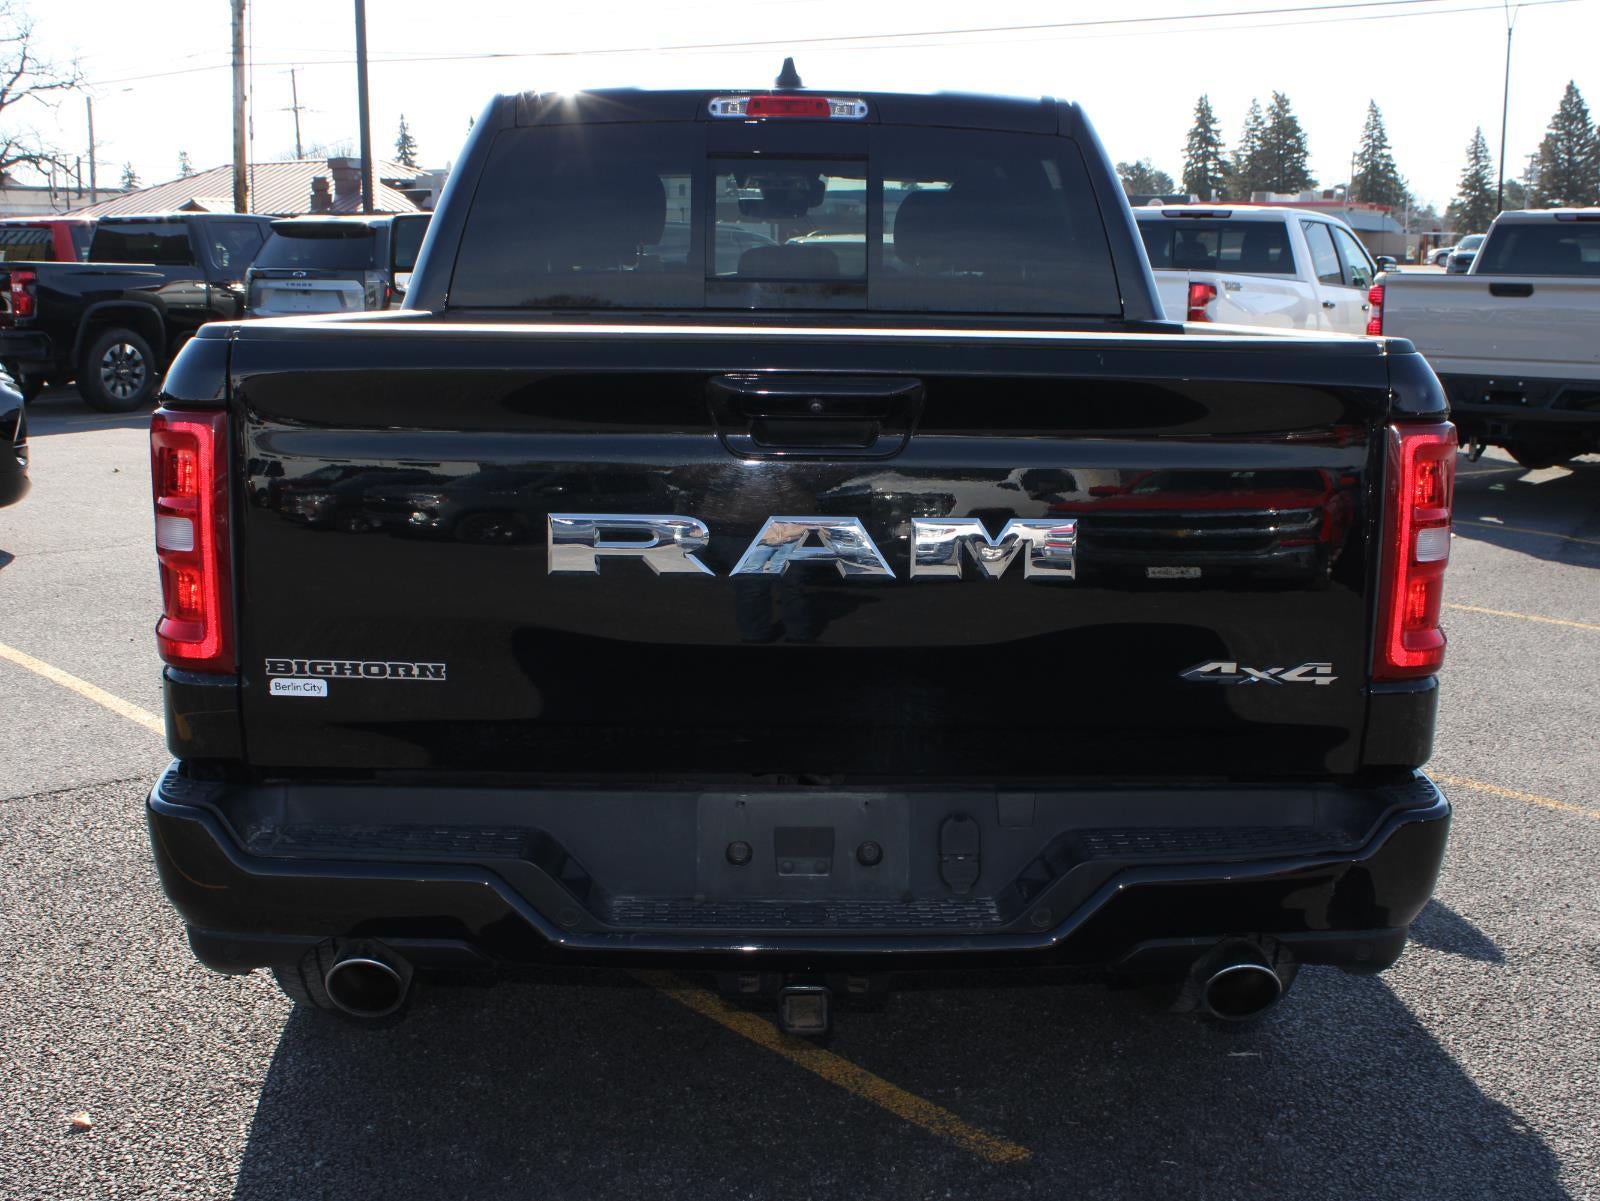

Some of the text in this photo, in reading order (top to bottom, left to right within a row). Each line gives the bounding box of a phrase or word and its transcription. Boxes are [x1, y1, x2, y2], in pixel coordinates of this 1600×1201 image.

[547, 513, 1078, 579] RAM
[265, 658, 446, 680] BIGHORN
[1179, 661, 1339, 685] 4x4
[274, 682, 322, 693] Berlin City
